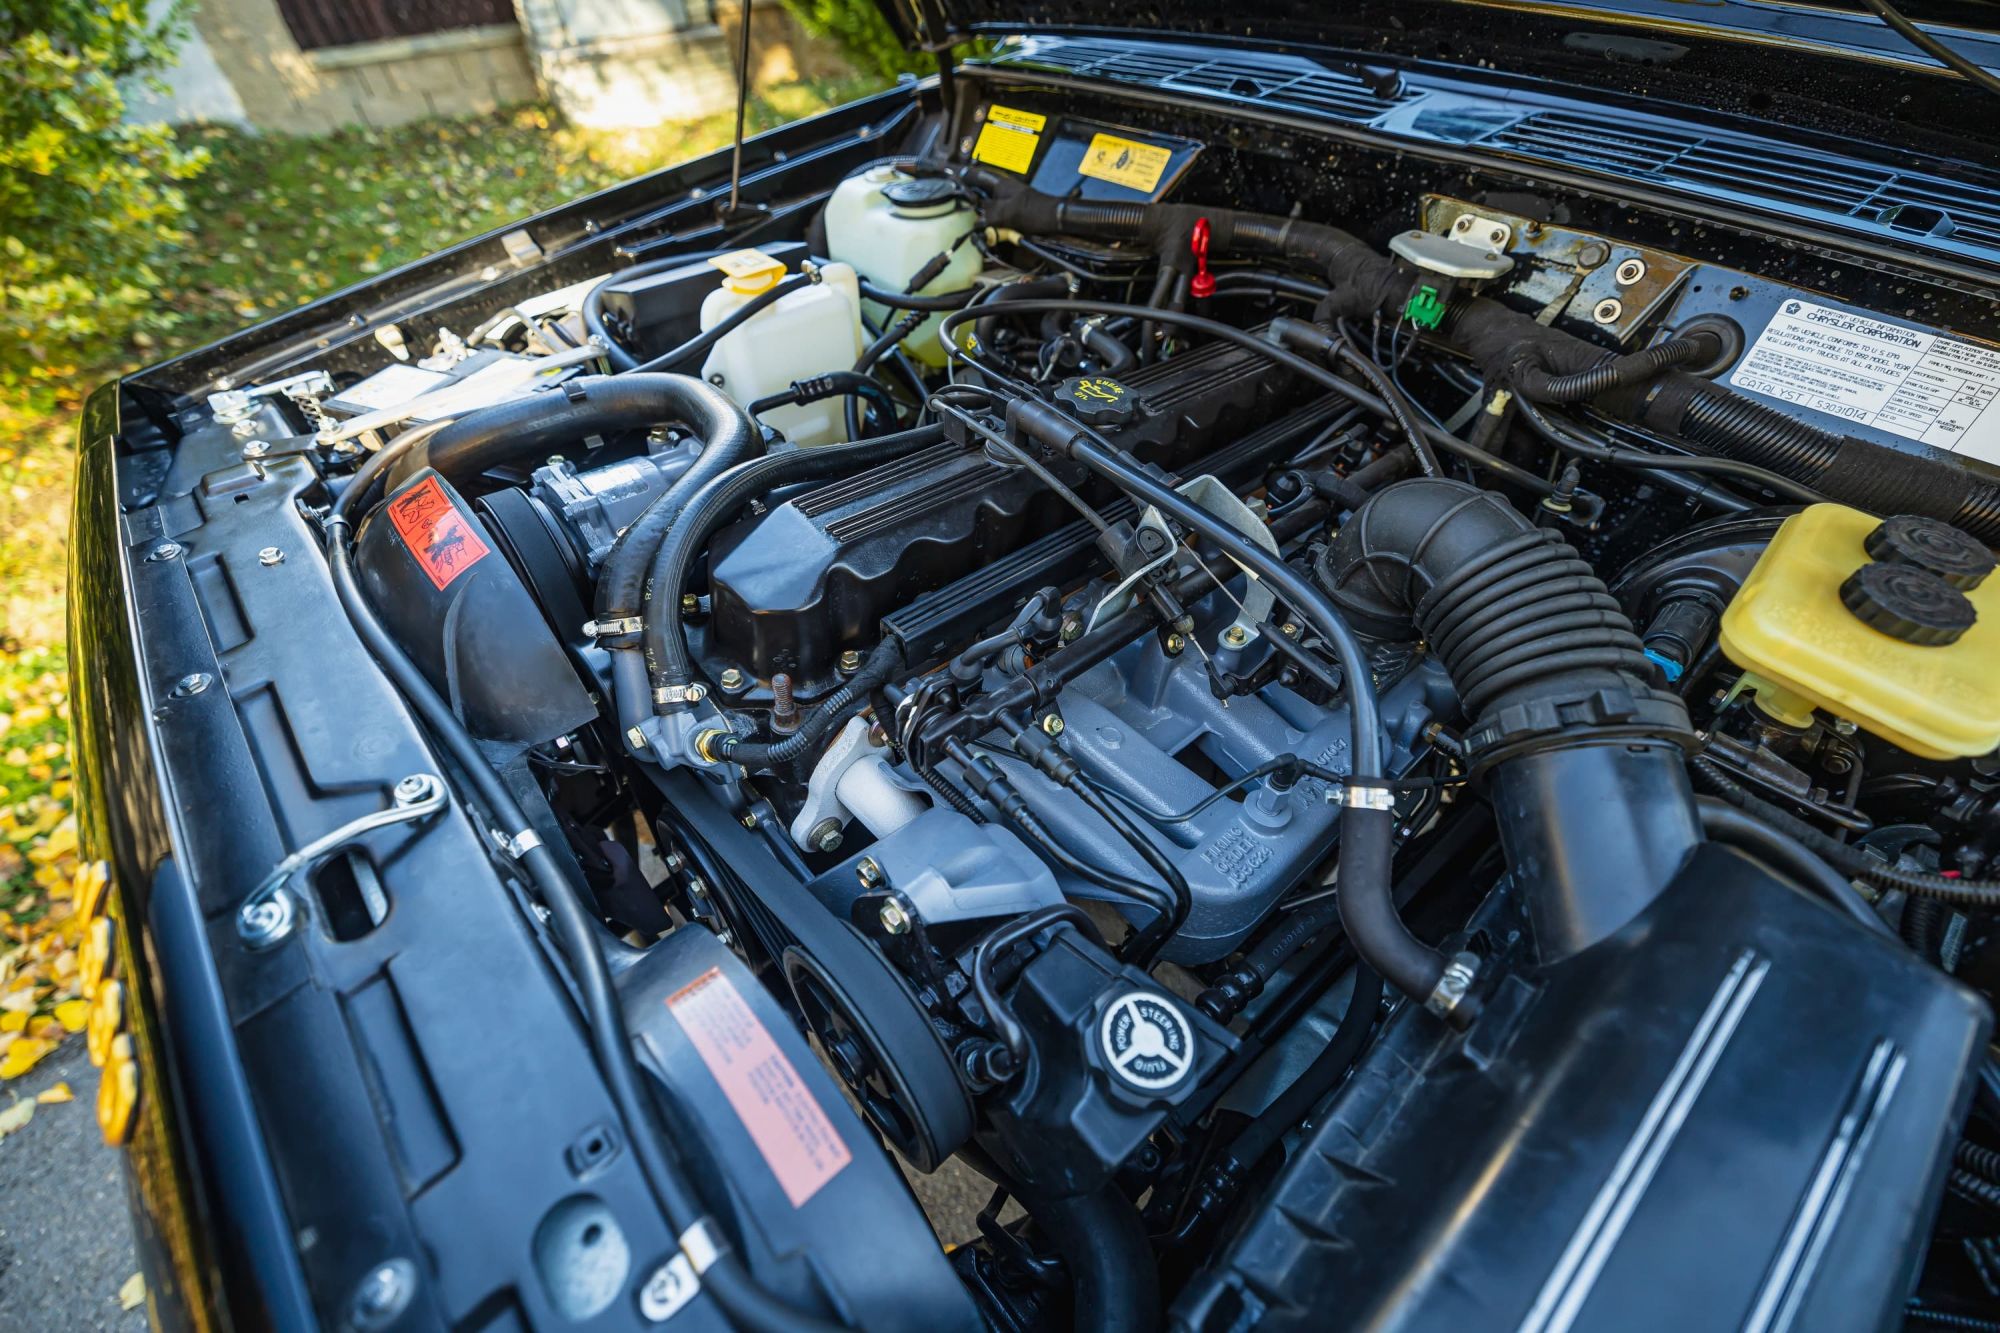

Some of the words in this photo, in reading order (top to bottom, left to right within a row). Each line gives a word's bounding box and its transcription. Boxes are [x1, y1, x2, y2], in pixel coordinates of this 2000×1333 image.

[1801, 329, 1825, 338] VEHICLE
[1828, 336, 1859, 347] CONFORMS
[1806, 313, 1854, 329] CHRYSLER
[1855, 326, 1921, 347] CORPORATION
[1877, 324, 1916, 337] INFORMATION
[1768, 328, 1805, 341] REGULATIONS
[1807, 339, 1841, 351] APPLICABLE
[1870, 357, 1891, 365] MODEL
[1817, 350, 1839, 359] TRUCKS
[1865, 364, 1900, 376] ALTITUDES
[1074, 391, 1089, 400] OIL
[1095, 379, 1124, 394] ENGINE
[1738, 377, 1804, 401] CATALYST
[1815, 400, 1866, 419] 53031014
[1200, 827, 1244, 864] FIRING
[1214, 838, 1260, 874] ORDER
[1116, 1013, 1132, 1051] POWER
[1140, 1006, 1179, 1050] STEERING
[1134, 1058, 1167, 1073] FLUID
